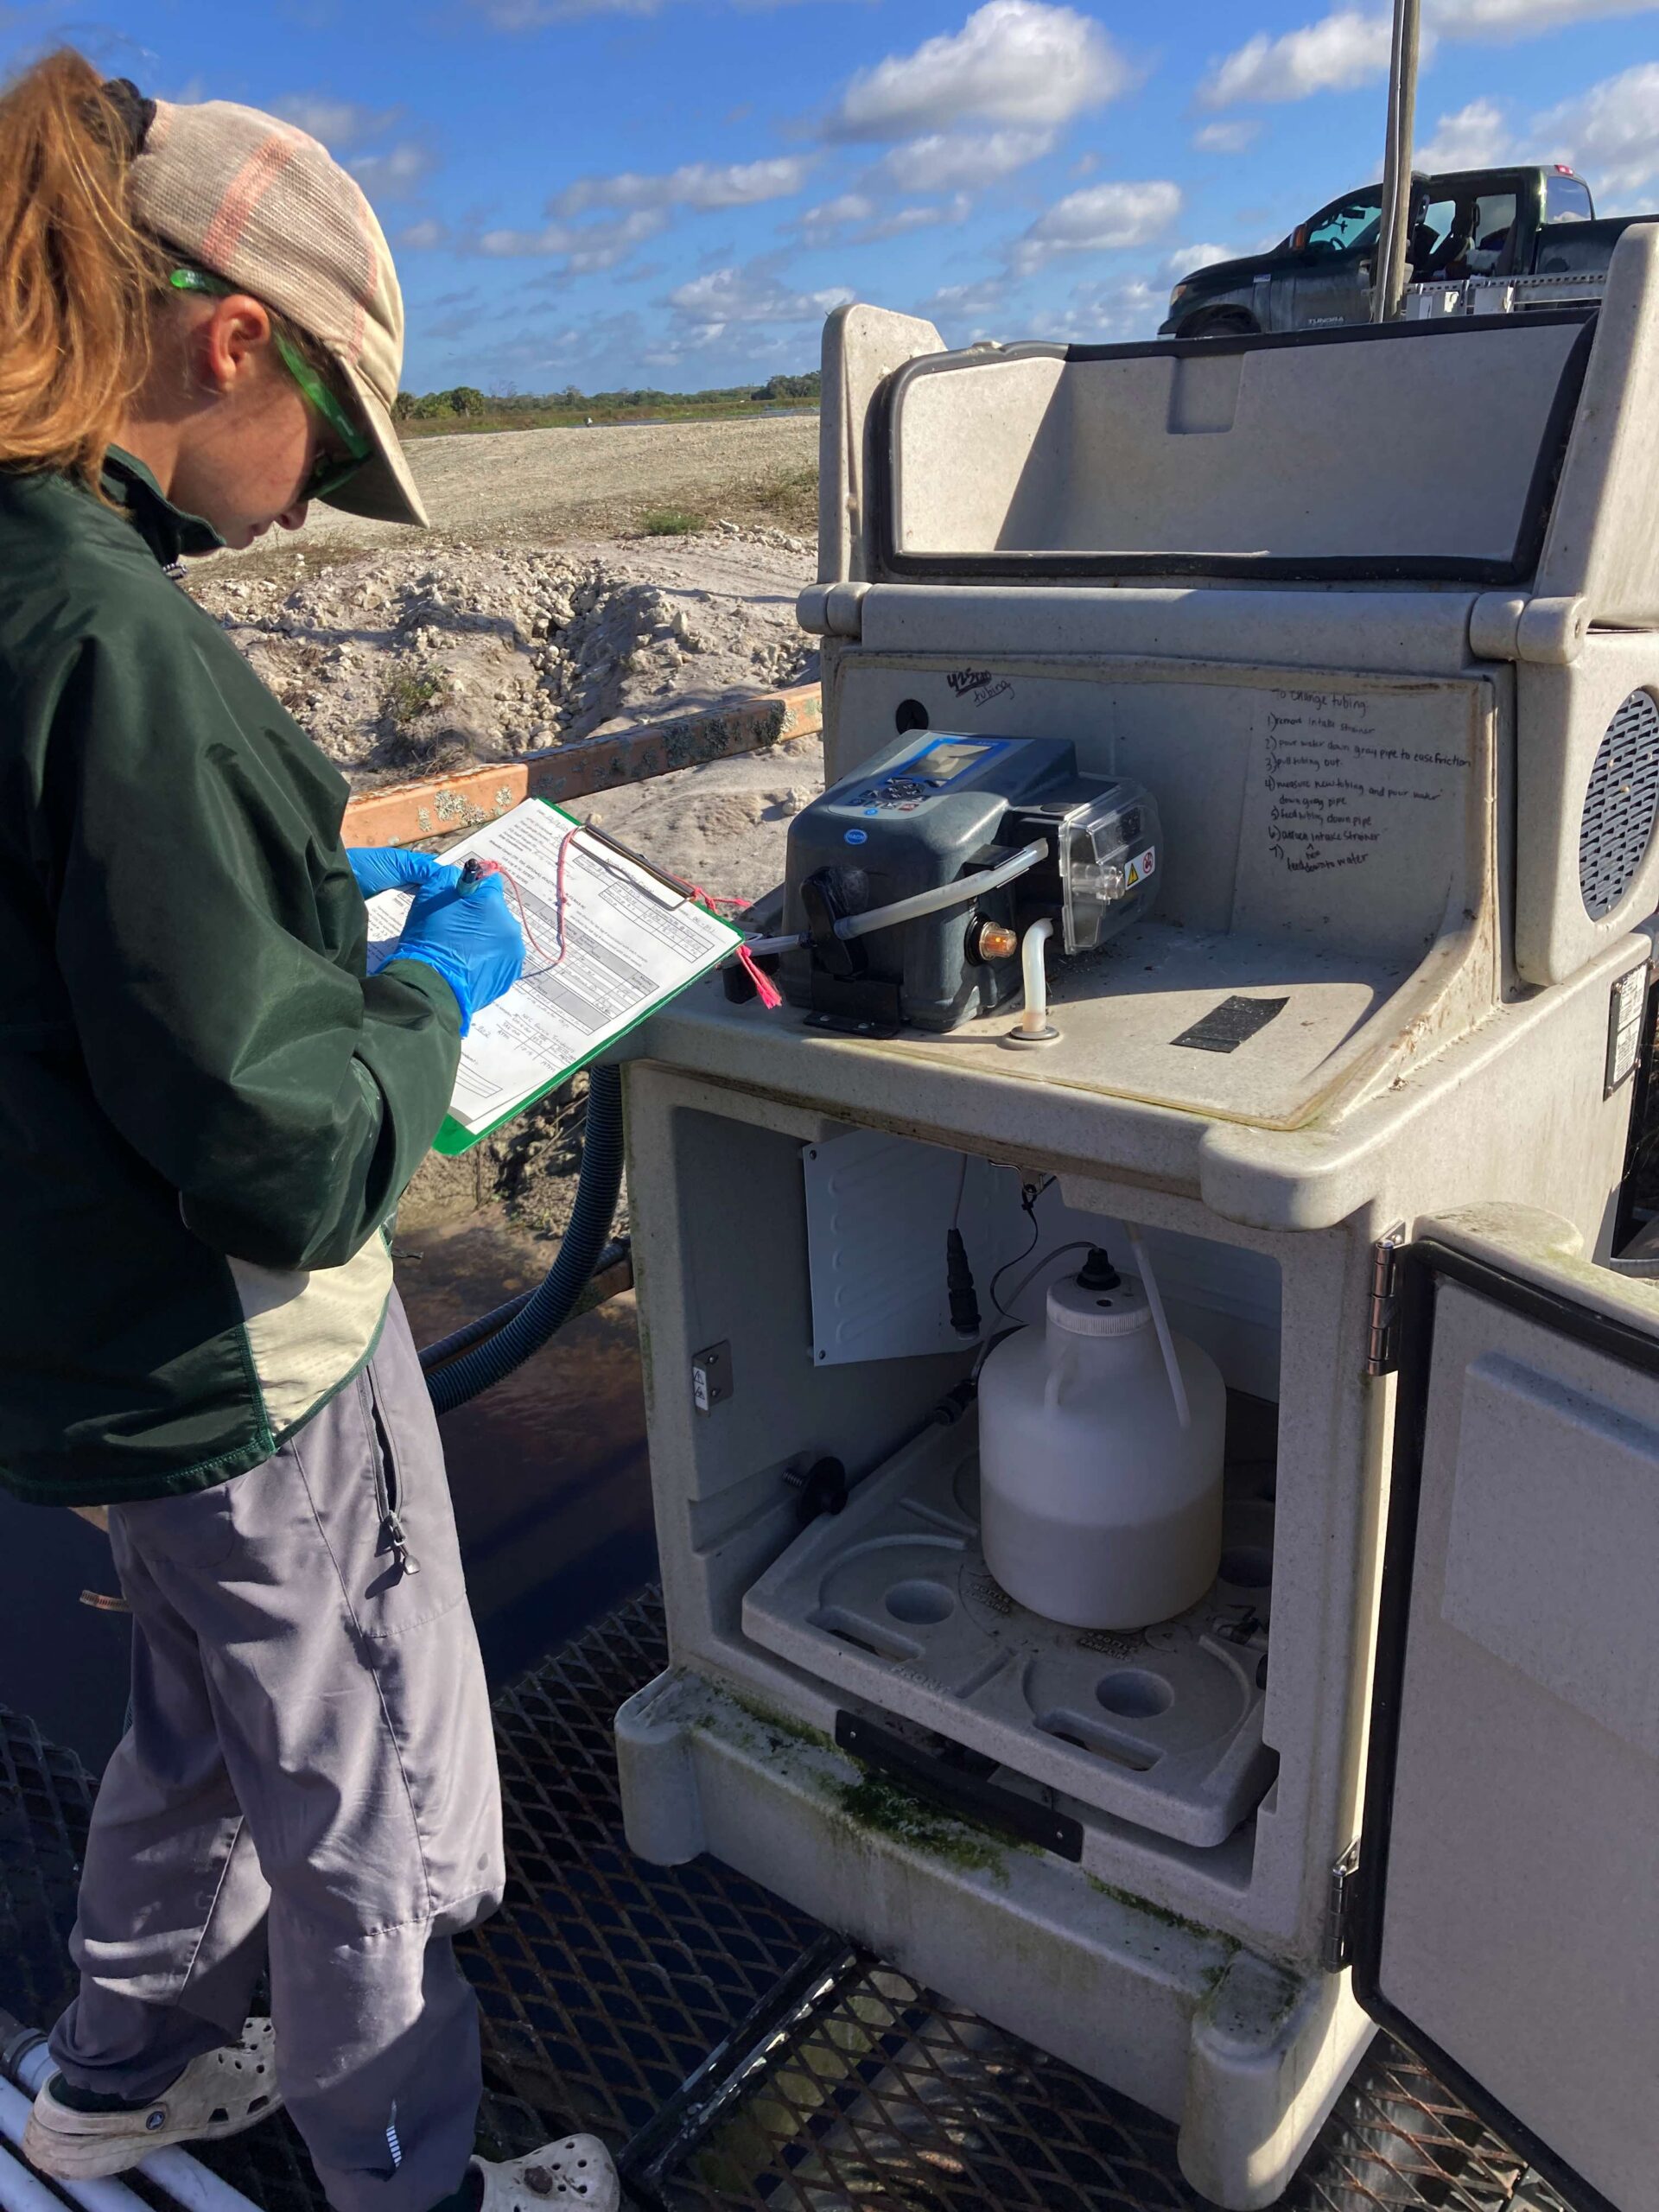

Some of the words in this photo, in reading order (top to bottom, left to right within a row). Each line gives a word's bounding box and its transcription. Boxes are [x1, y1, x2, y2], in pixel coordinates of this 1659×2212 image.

[1380, 748, 1399, 760] pipe
[1401, 748, 1410, 760] to
[1434, 753, 1471, 767] friction
